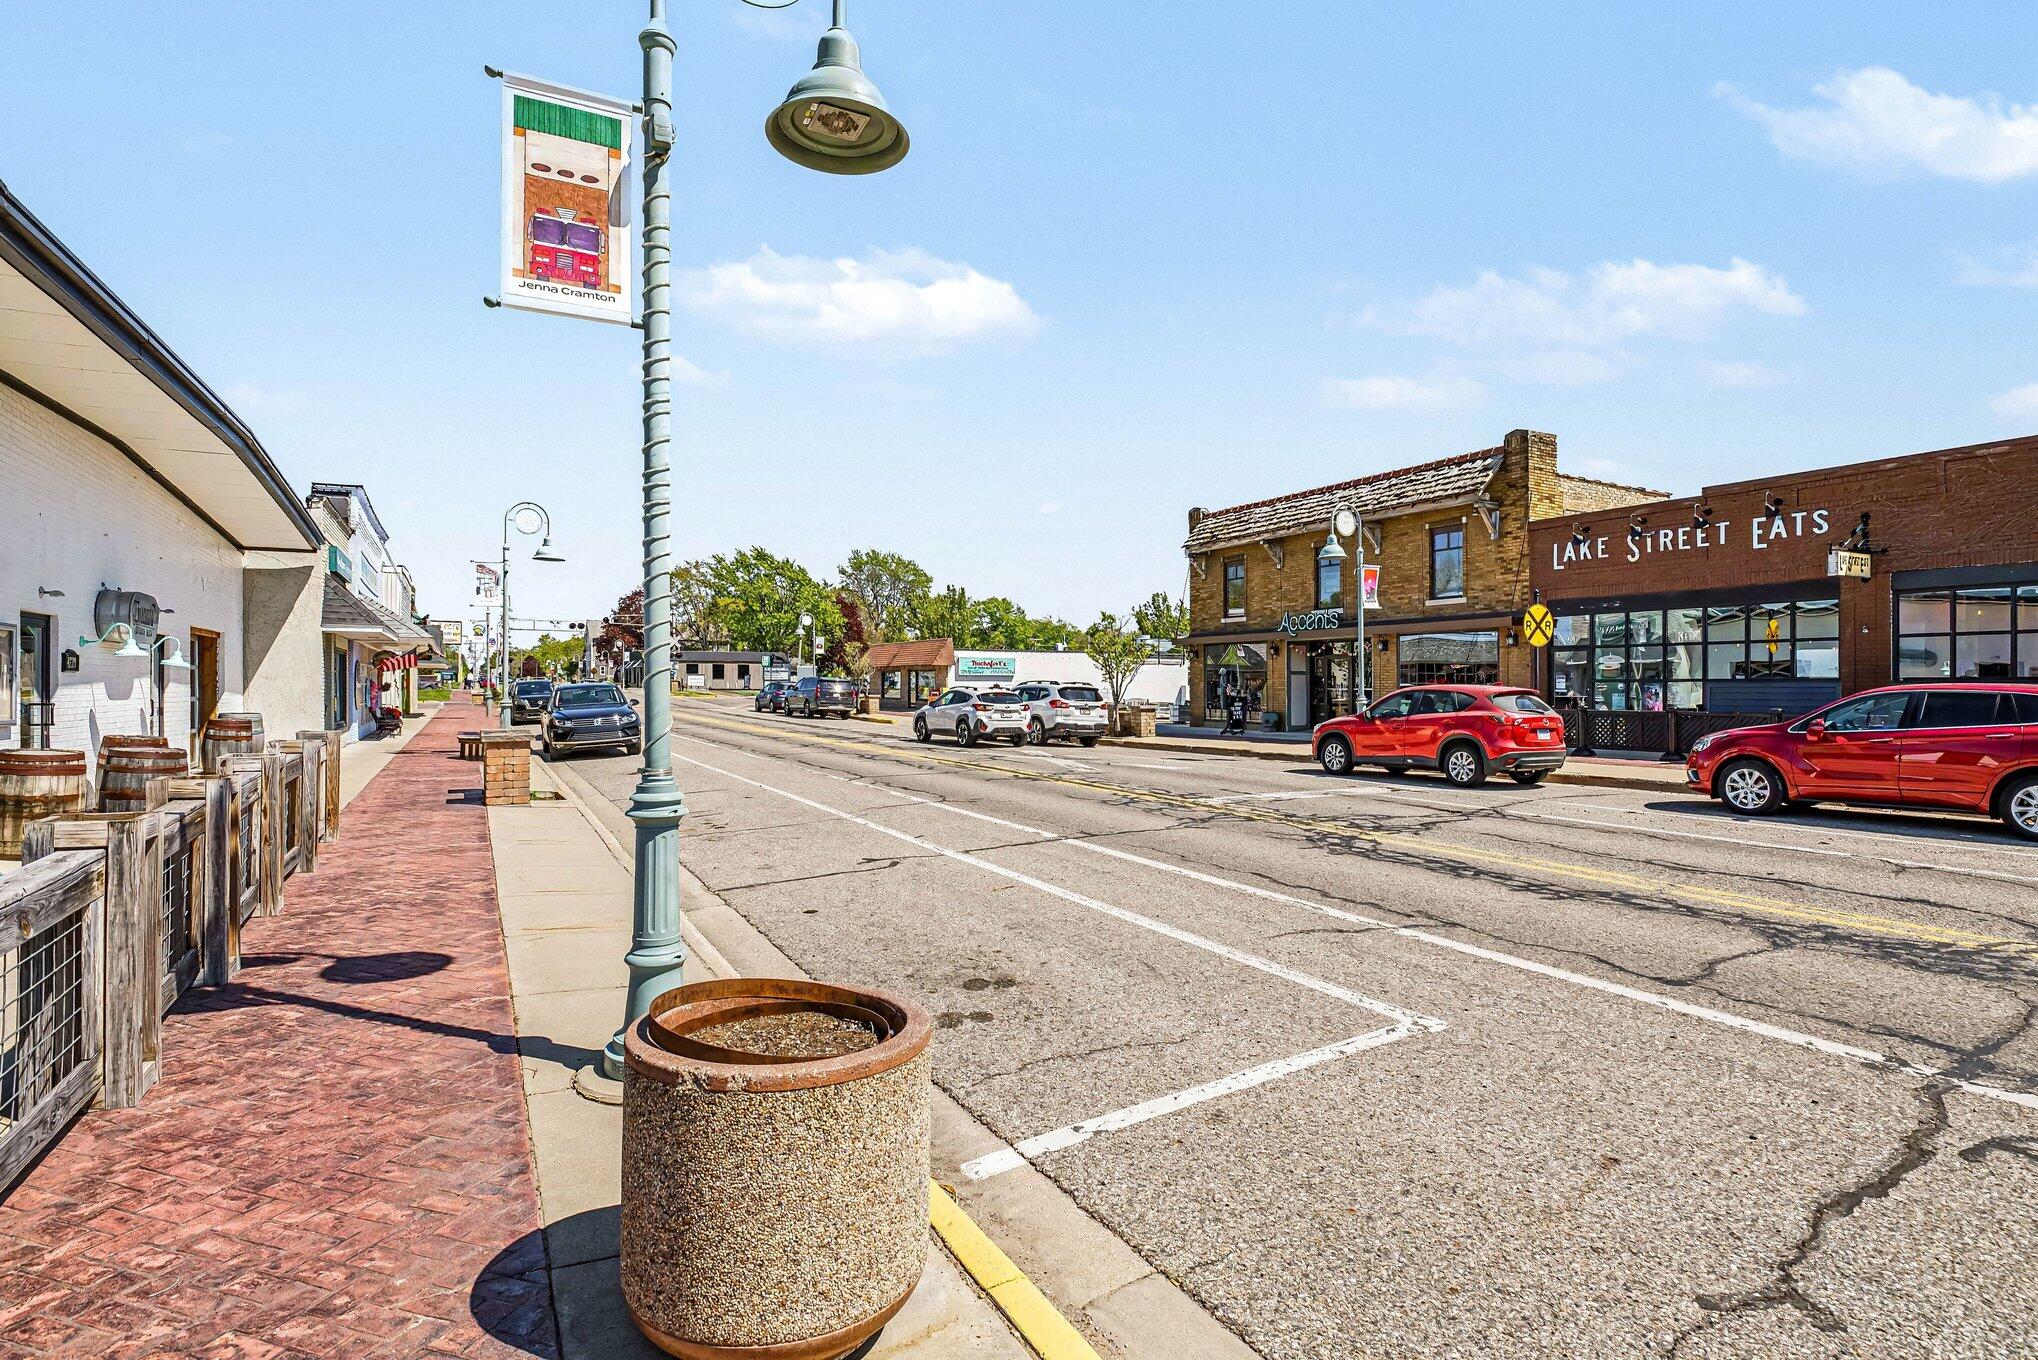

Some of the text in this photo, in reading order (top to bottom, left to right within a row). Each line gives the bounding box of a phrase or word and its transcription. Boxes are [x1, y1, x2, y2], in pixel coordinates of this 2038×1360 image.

[518, 280, 616, 303] Jenna Cramton
[1553, 509, 1830, 570] LAKE STREET EATS
[1277, 609, 1339, 636] Accents
